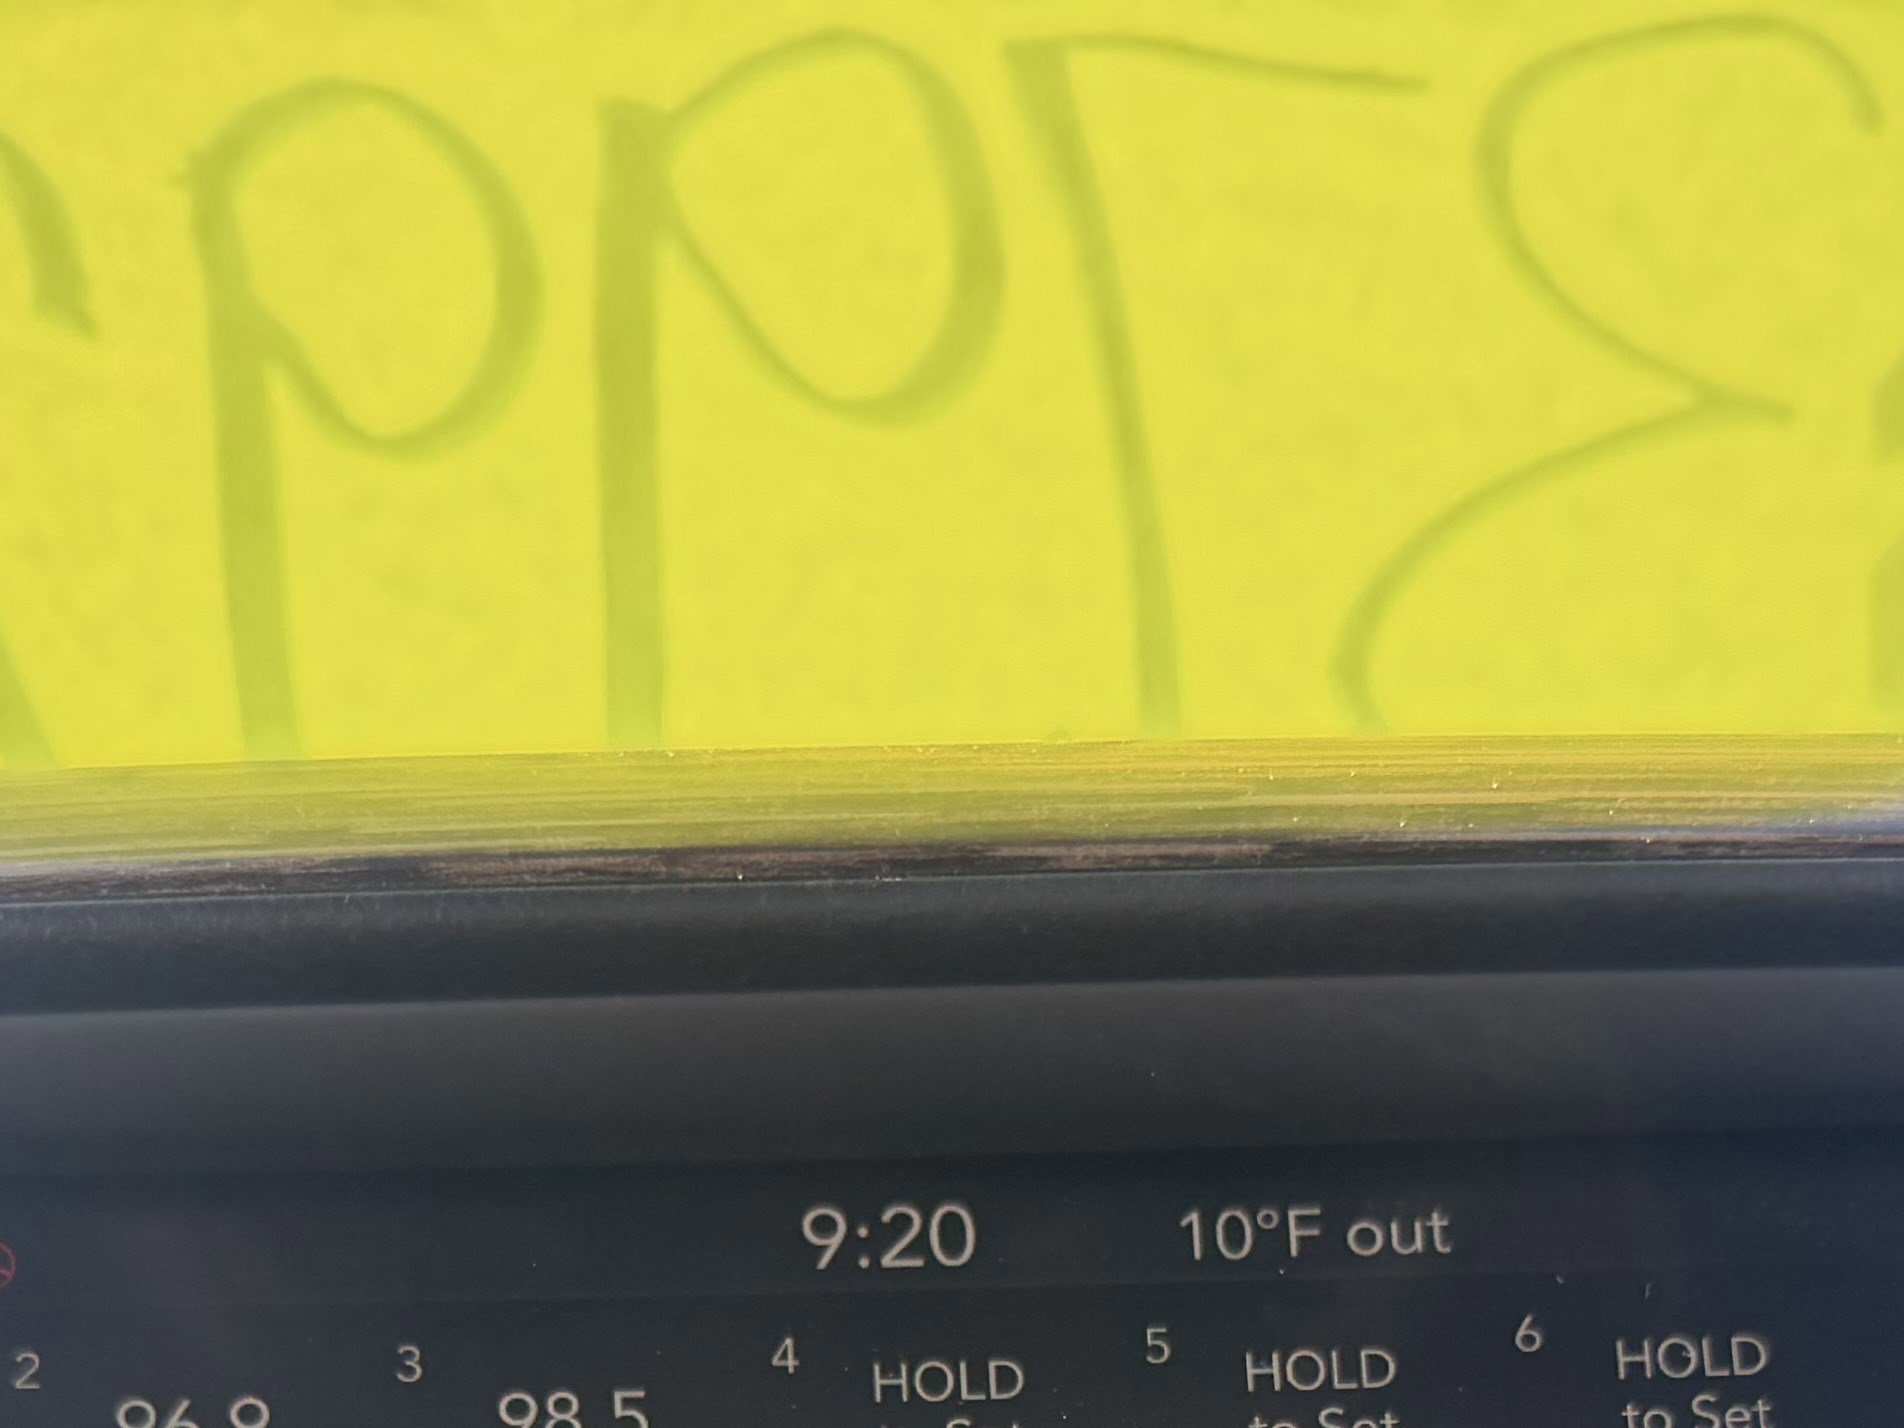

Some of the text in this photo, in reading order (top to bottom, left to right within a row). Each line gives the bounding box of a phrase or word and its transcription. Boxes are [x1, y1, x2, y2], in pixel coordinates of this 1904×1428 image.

[802, 1204, 976, 1270] 9:20
[1180, 1207, 1451, 1260] 10°F out
[1146, 1327, 1171, 1364] 5
[1514, 1315, 1542, 1353] 6
[13, 1351, 40, 1390] 2
[396, 1345, 423, 1383] 3
[771, 1337, 799, 1374] 4
[1245, 1348, 1396, 1392] HOLD
[1616, 1335, 1768, 1380] HOLD
[873, 1359, 1025, 1403] HOLD
